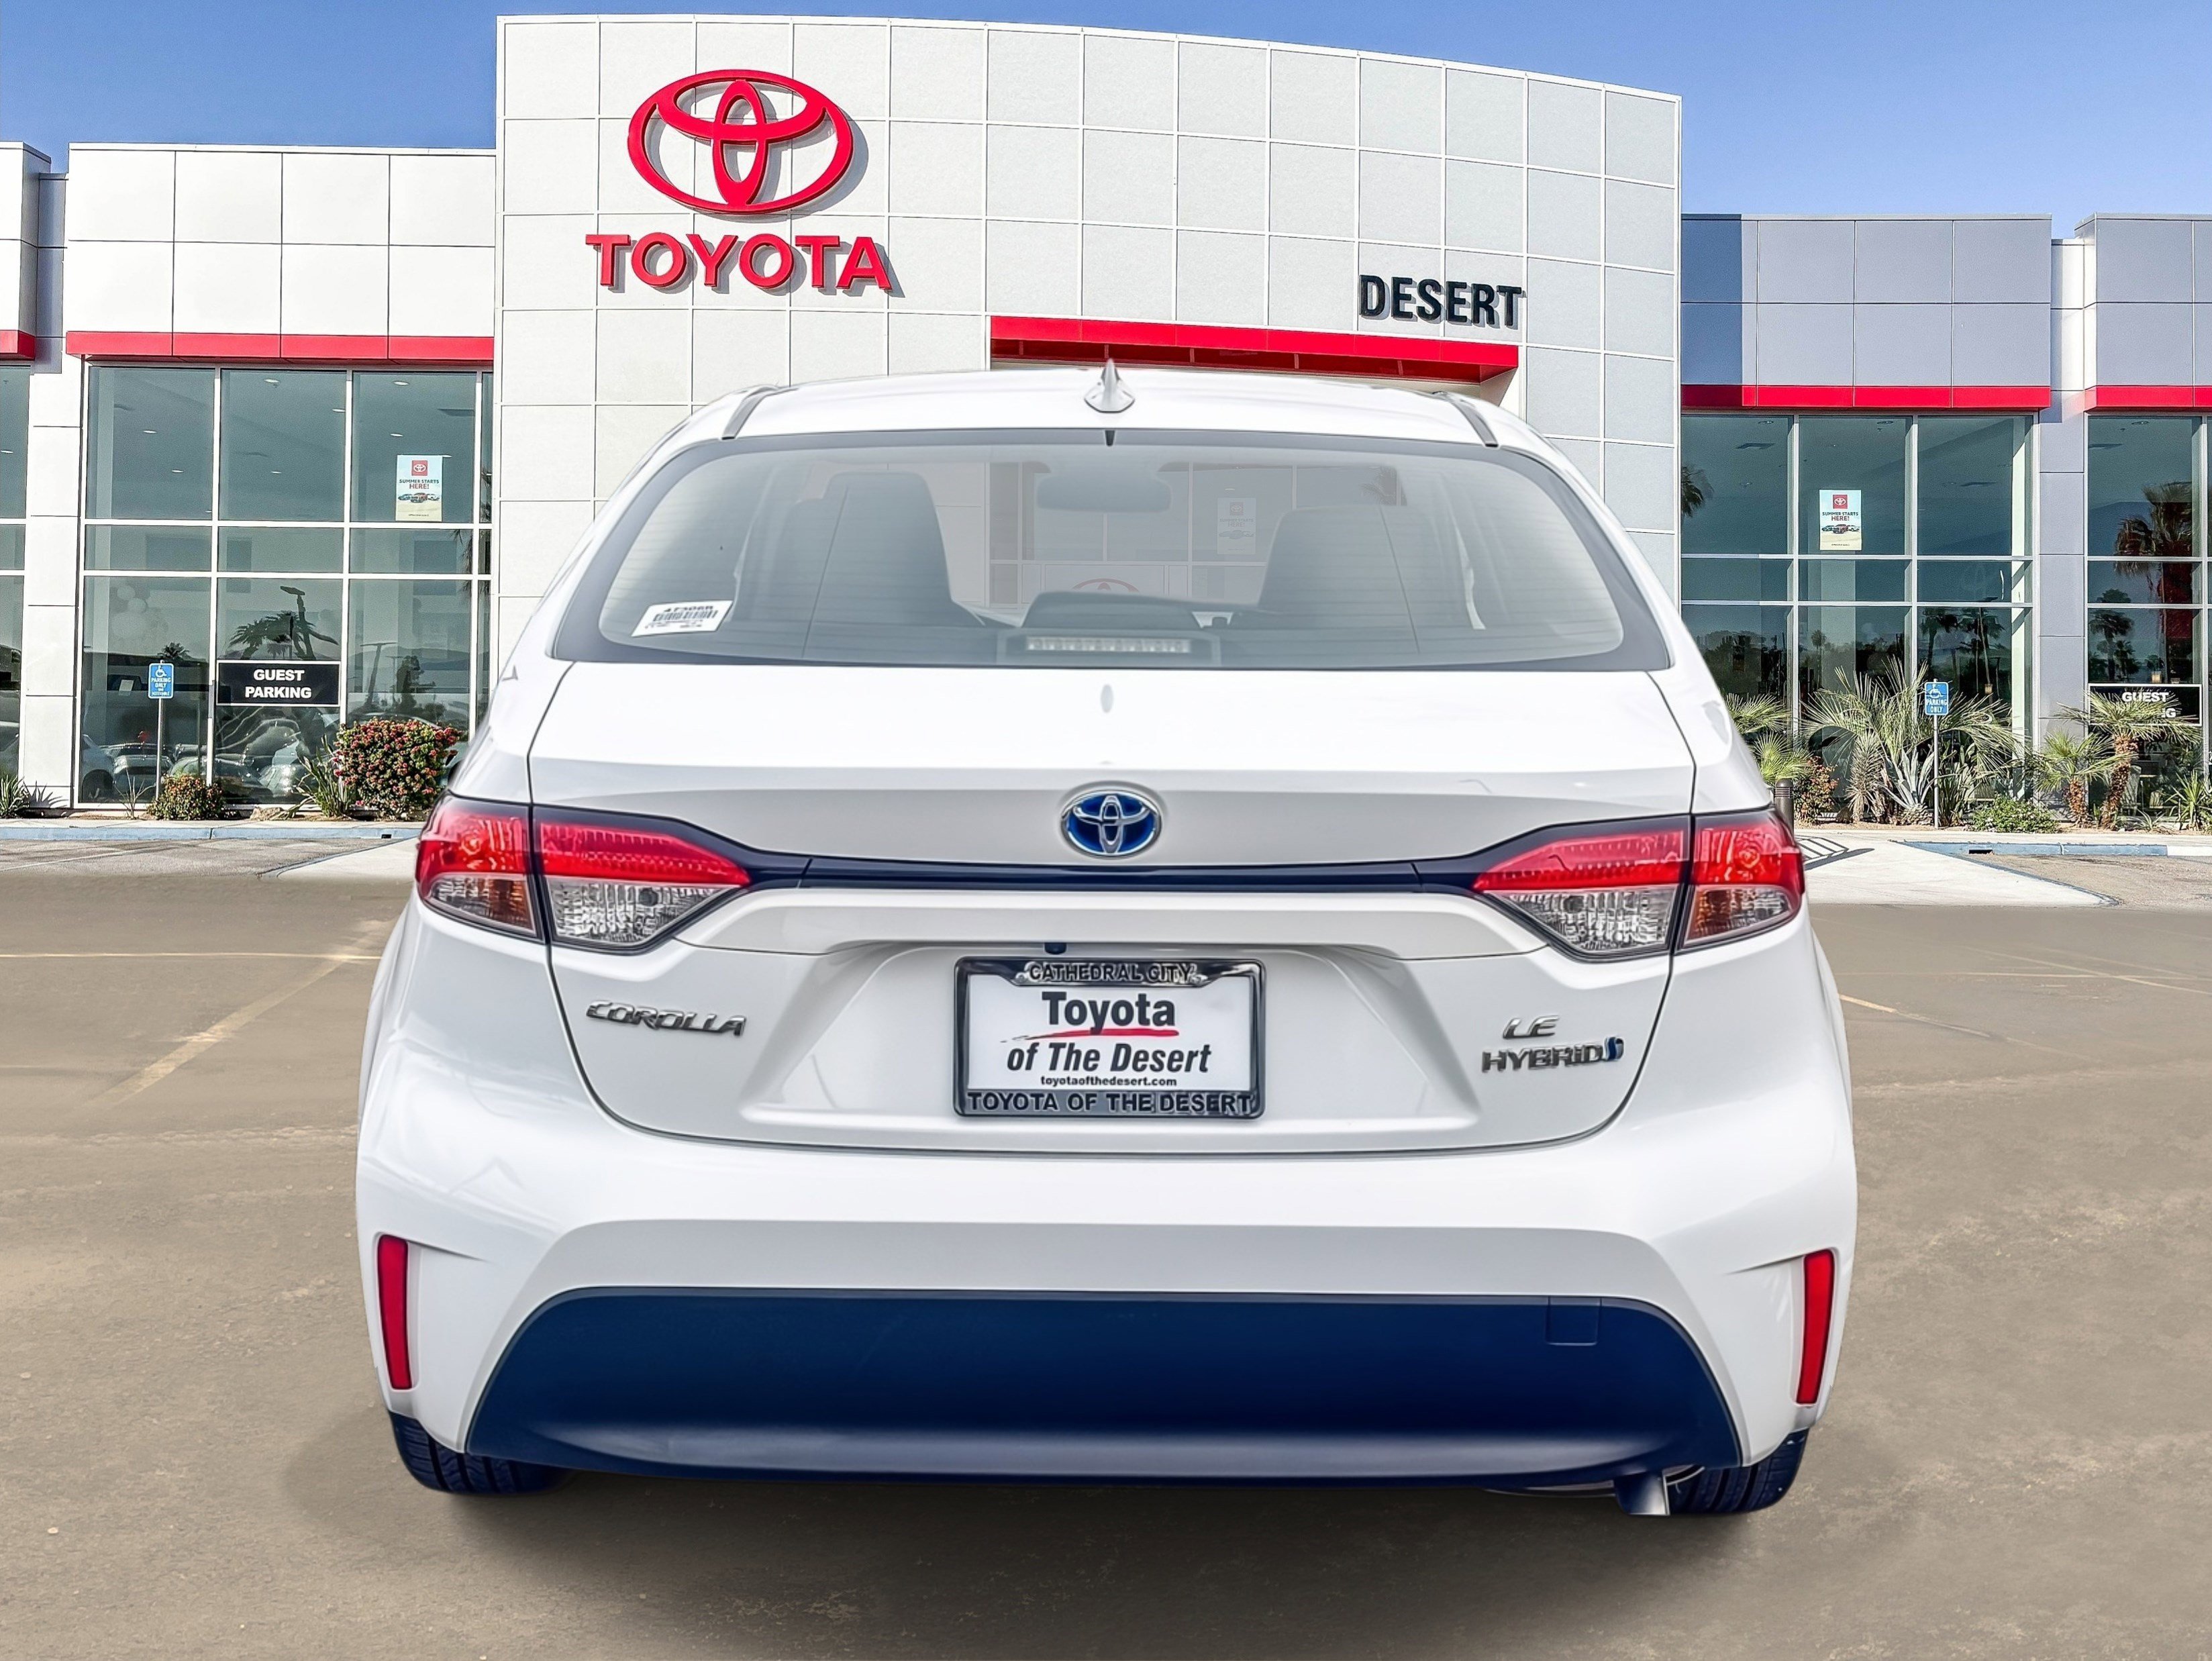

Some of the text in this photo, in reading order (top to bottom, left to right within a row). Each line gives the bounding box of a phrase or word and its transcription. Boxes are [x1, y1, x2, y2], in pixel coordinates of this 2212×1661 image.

[585, 232, 893, 291] TOYOTA
[1359, 274, 1522, 327] DESERT
[253, 669, 305, 681] GUEST
[245, 687, 312, 699] PARKING
[1926, 698, 1948, 706] PARKING
[2121, 691, 2170, 703] GUEST
[1930, 705, 1944, 713] ONLY
[1028, 962, 1195, 983] CATHEDRAL CITY
[587, 1000, 746, 1036] COROLLA
[1042, 991, 1175, 1035] Toyota
[1503, 1015, 1560, 1039] LE
[1007, 1042, 1211, 1073] of The Desert
[1482, 1044, 1603, 1072] HYBRID
[1040, 1076, 1178, 1087] toyotaofthedesert.com
[967, 1091, 1253, 1114] TOYOTA OF THE DESERT
